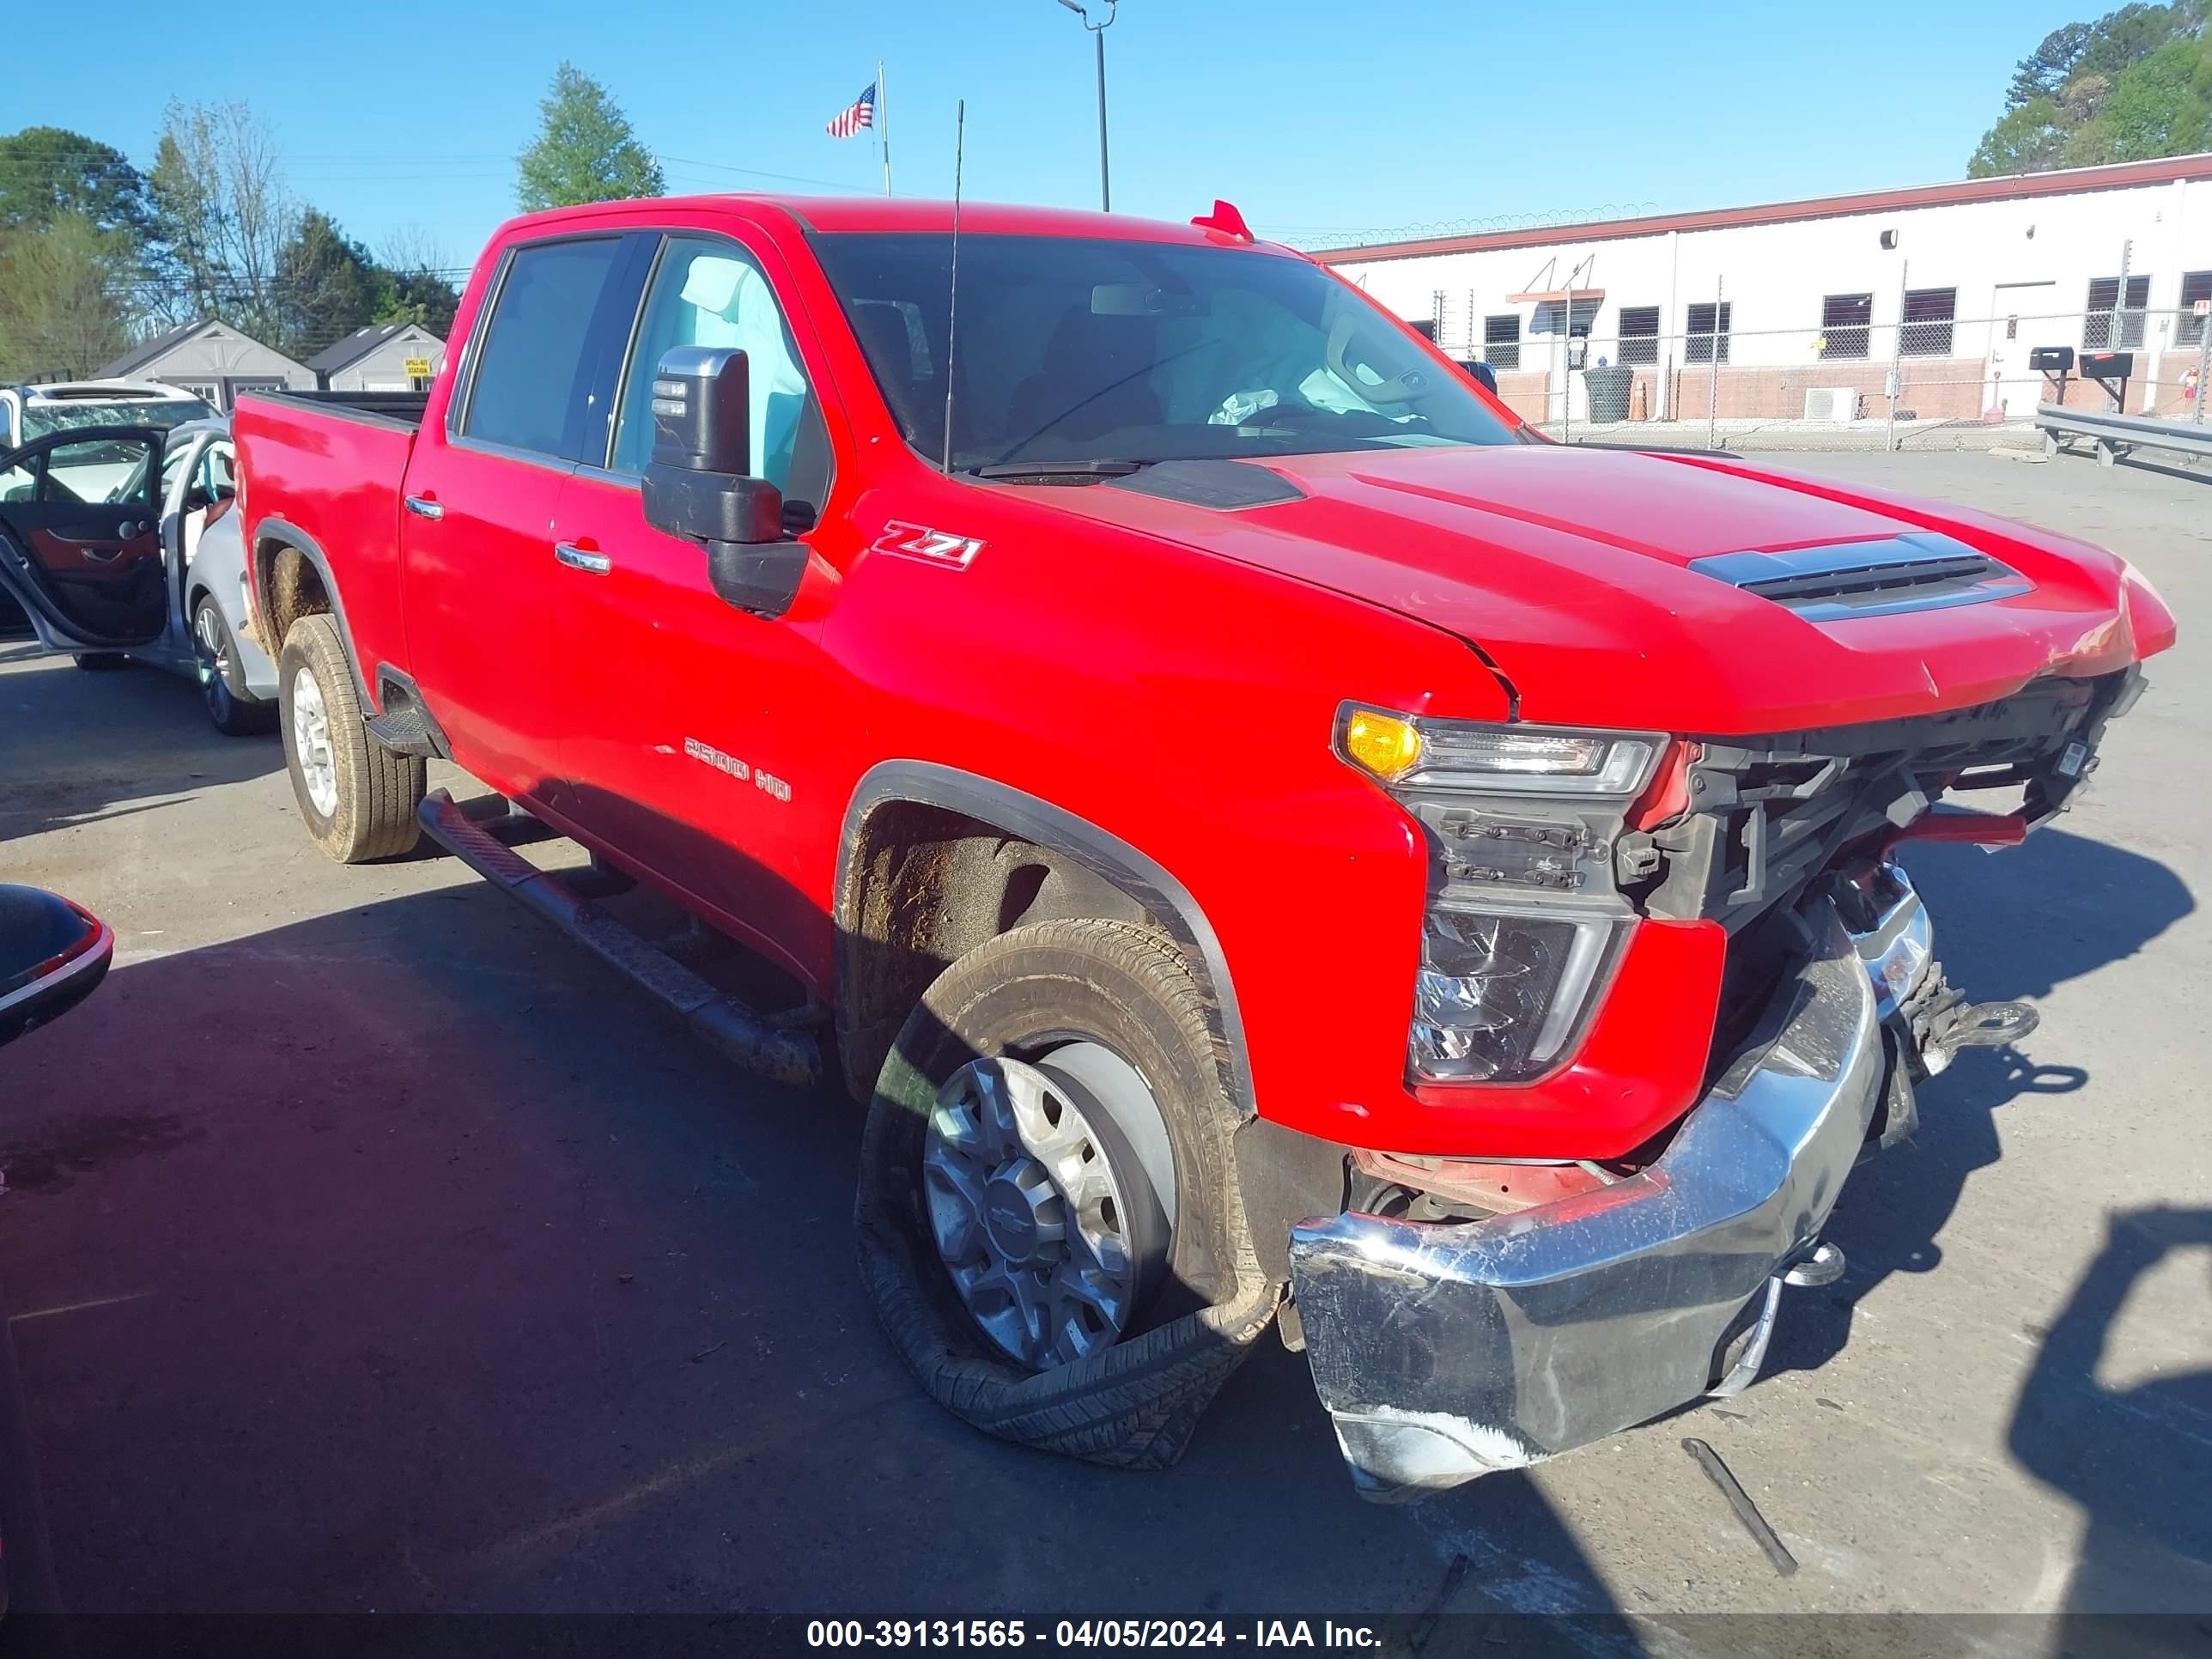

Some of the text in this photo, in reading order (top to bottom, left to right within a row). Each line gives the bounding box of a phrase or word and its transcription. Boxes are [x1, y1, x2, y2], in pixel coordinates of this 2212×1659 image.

[870, 520, 988, 573] Z71
[684, 737, 792, 803] 2500 HD
